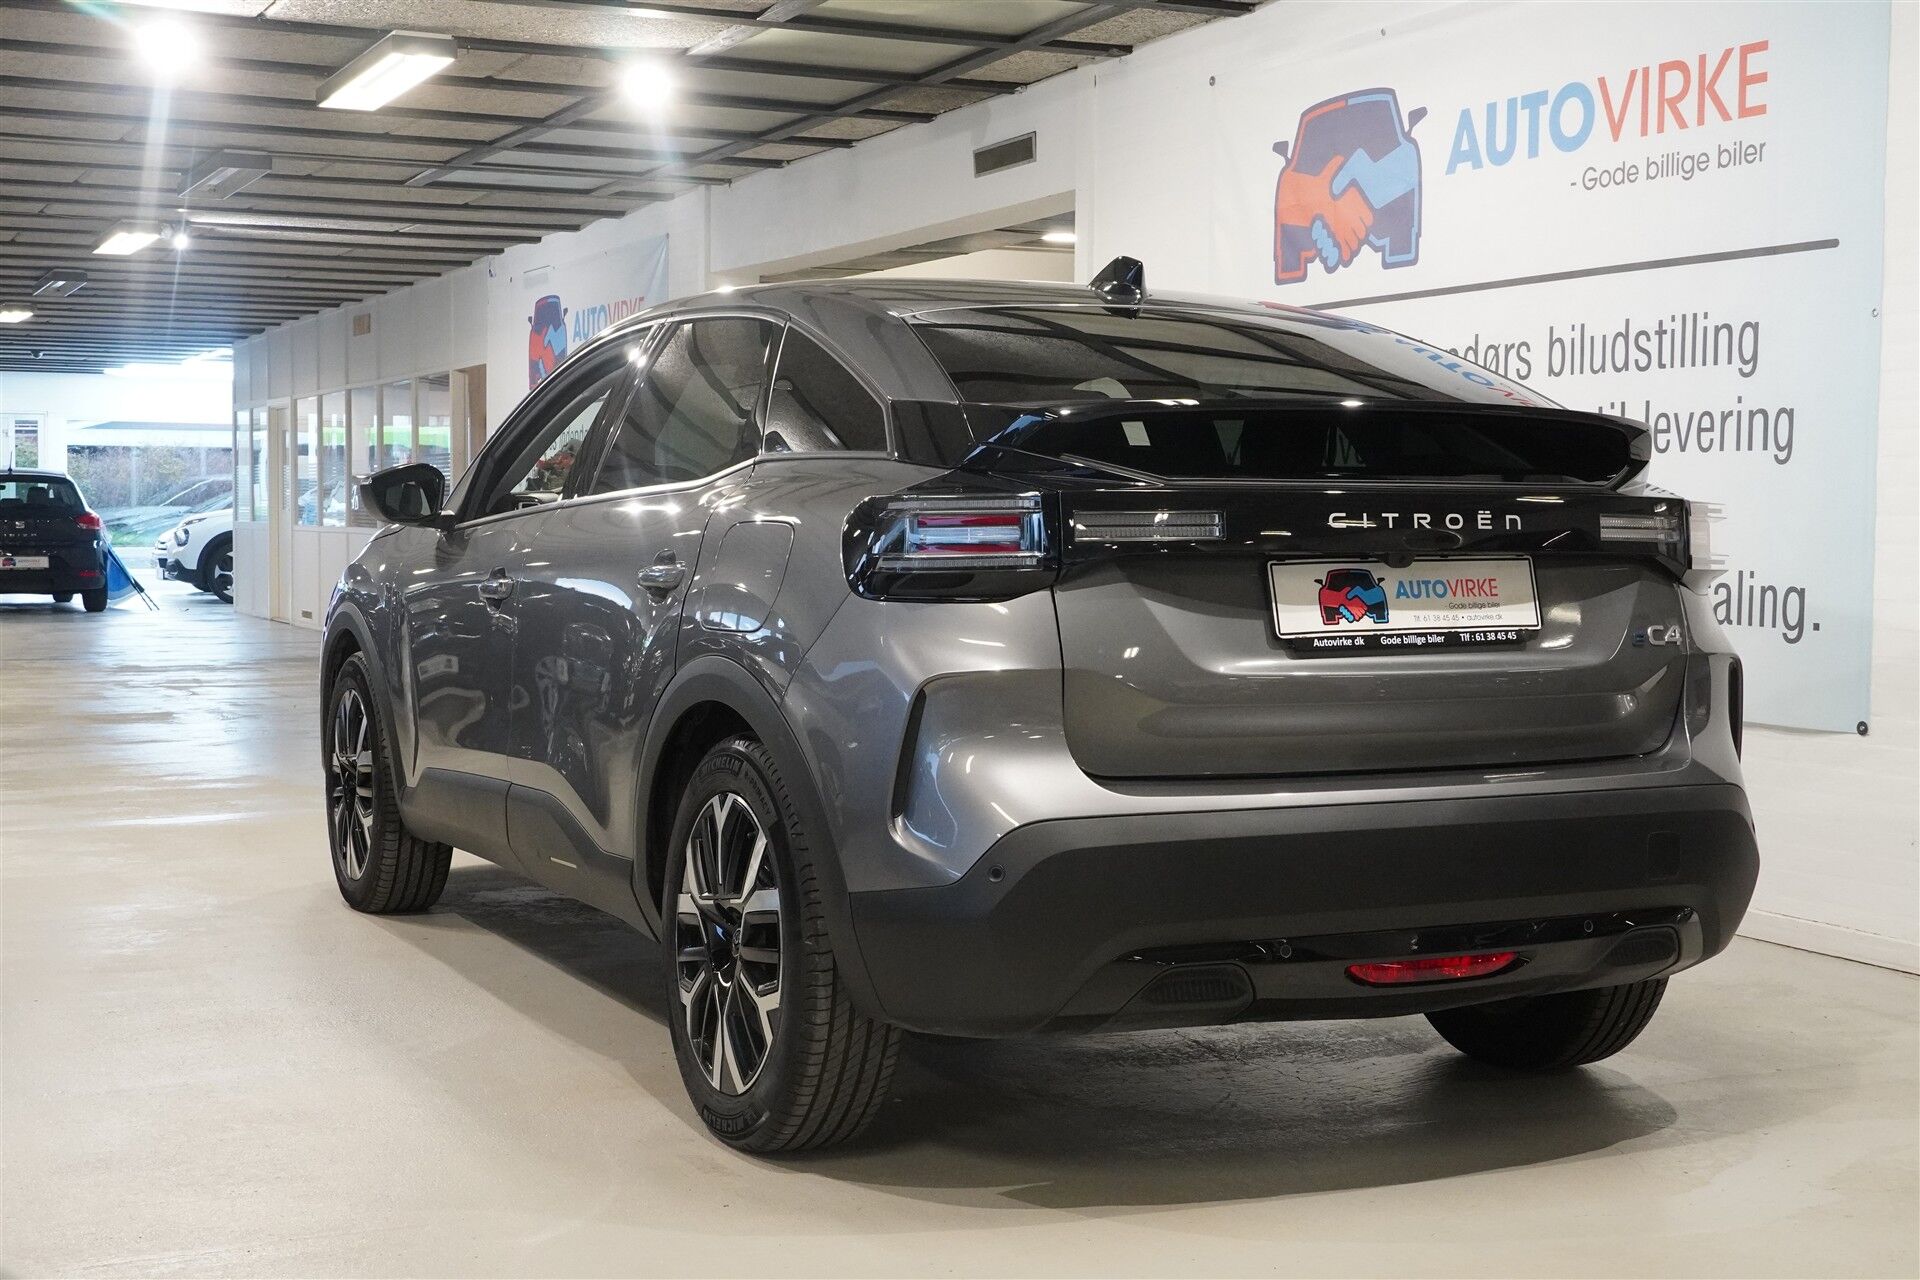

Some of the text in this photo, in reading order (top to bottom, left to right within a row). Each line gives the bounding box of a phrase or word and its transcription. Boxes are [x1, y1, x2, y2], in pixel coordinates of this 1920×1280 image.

[1445, 39, 1769, 175] AUTOVIRKE
[1582, 161, 1639, 191] Gode
[1646, 151, 1710, 181] billige
[1717, 140, 1766, 169] biler
[1548, 312, 1760, 378] biludstilling
[1395, 578, 1499, 599] AUTOVIRKE
[1448, 602, 1468, 610] Gode
[1442, 614, 1450, 622] 45
[1380, 634, 1445, 645] Gode billige biler
[1475, 633, 1485, 641] 61
[1486, 632, 1496, 641] 38
[1497, 632, 1506, 640] 45
[1507, 631, 1517, 640] 45
[1313, 637, 1365, 647] Autovirke dk
